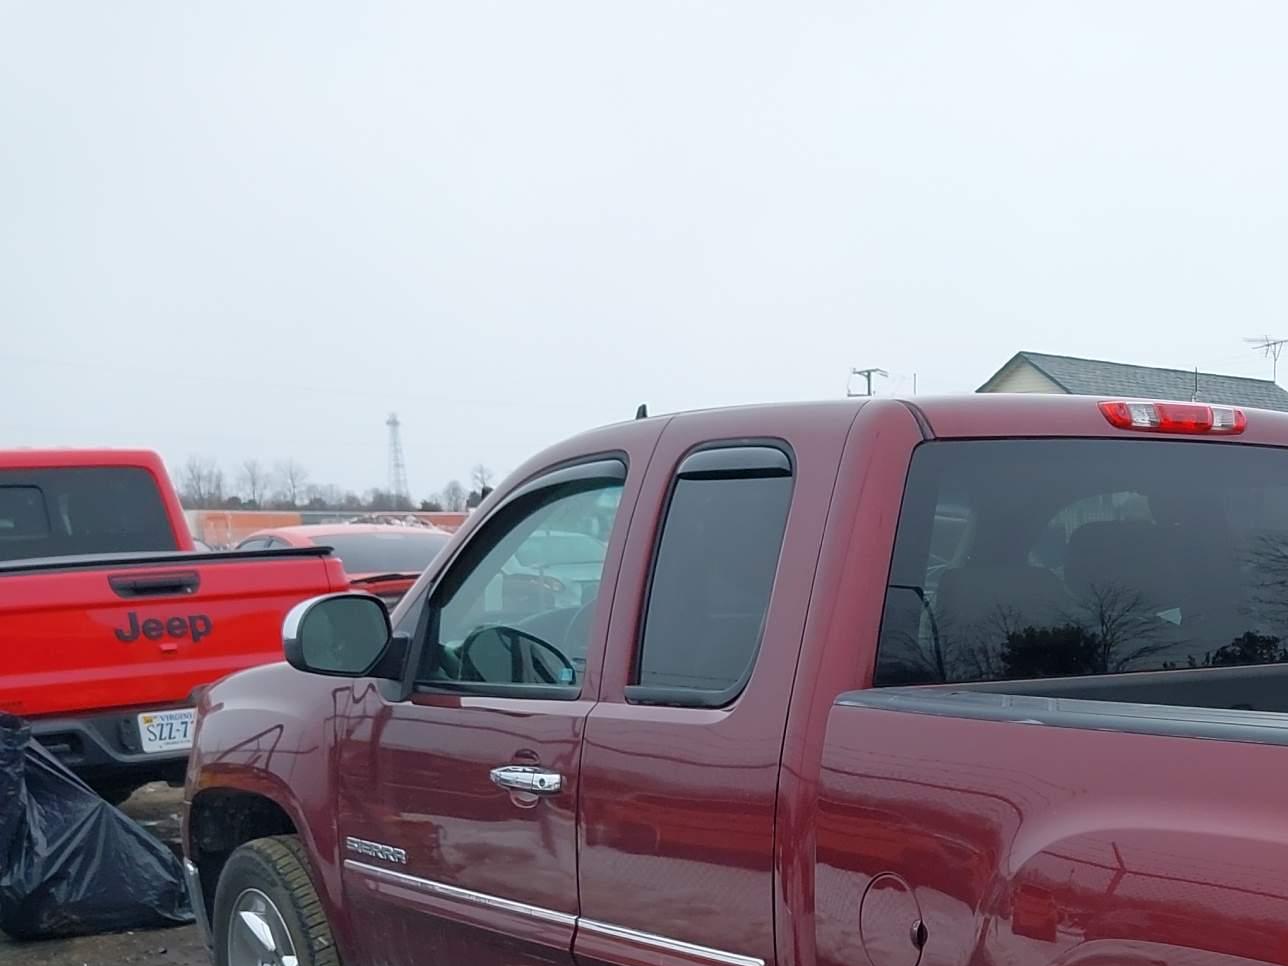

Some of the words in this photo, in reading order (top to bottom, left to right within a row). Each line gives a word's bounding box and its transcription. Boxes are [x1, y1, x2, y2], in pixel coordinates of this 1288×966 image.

[114, 611, 213, 643] Jeep
[160, 711, 193, 722] VIRGINI
[146, 720, 194, 742] SZZ-7
[346, 836, 407, 865] SIERRA
